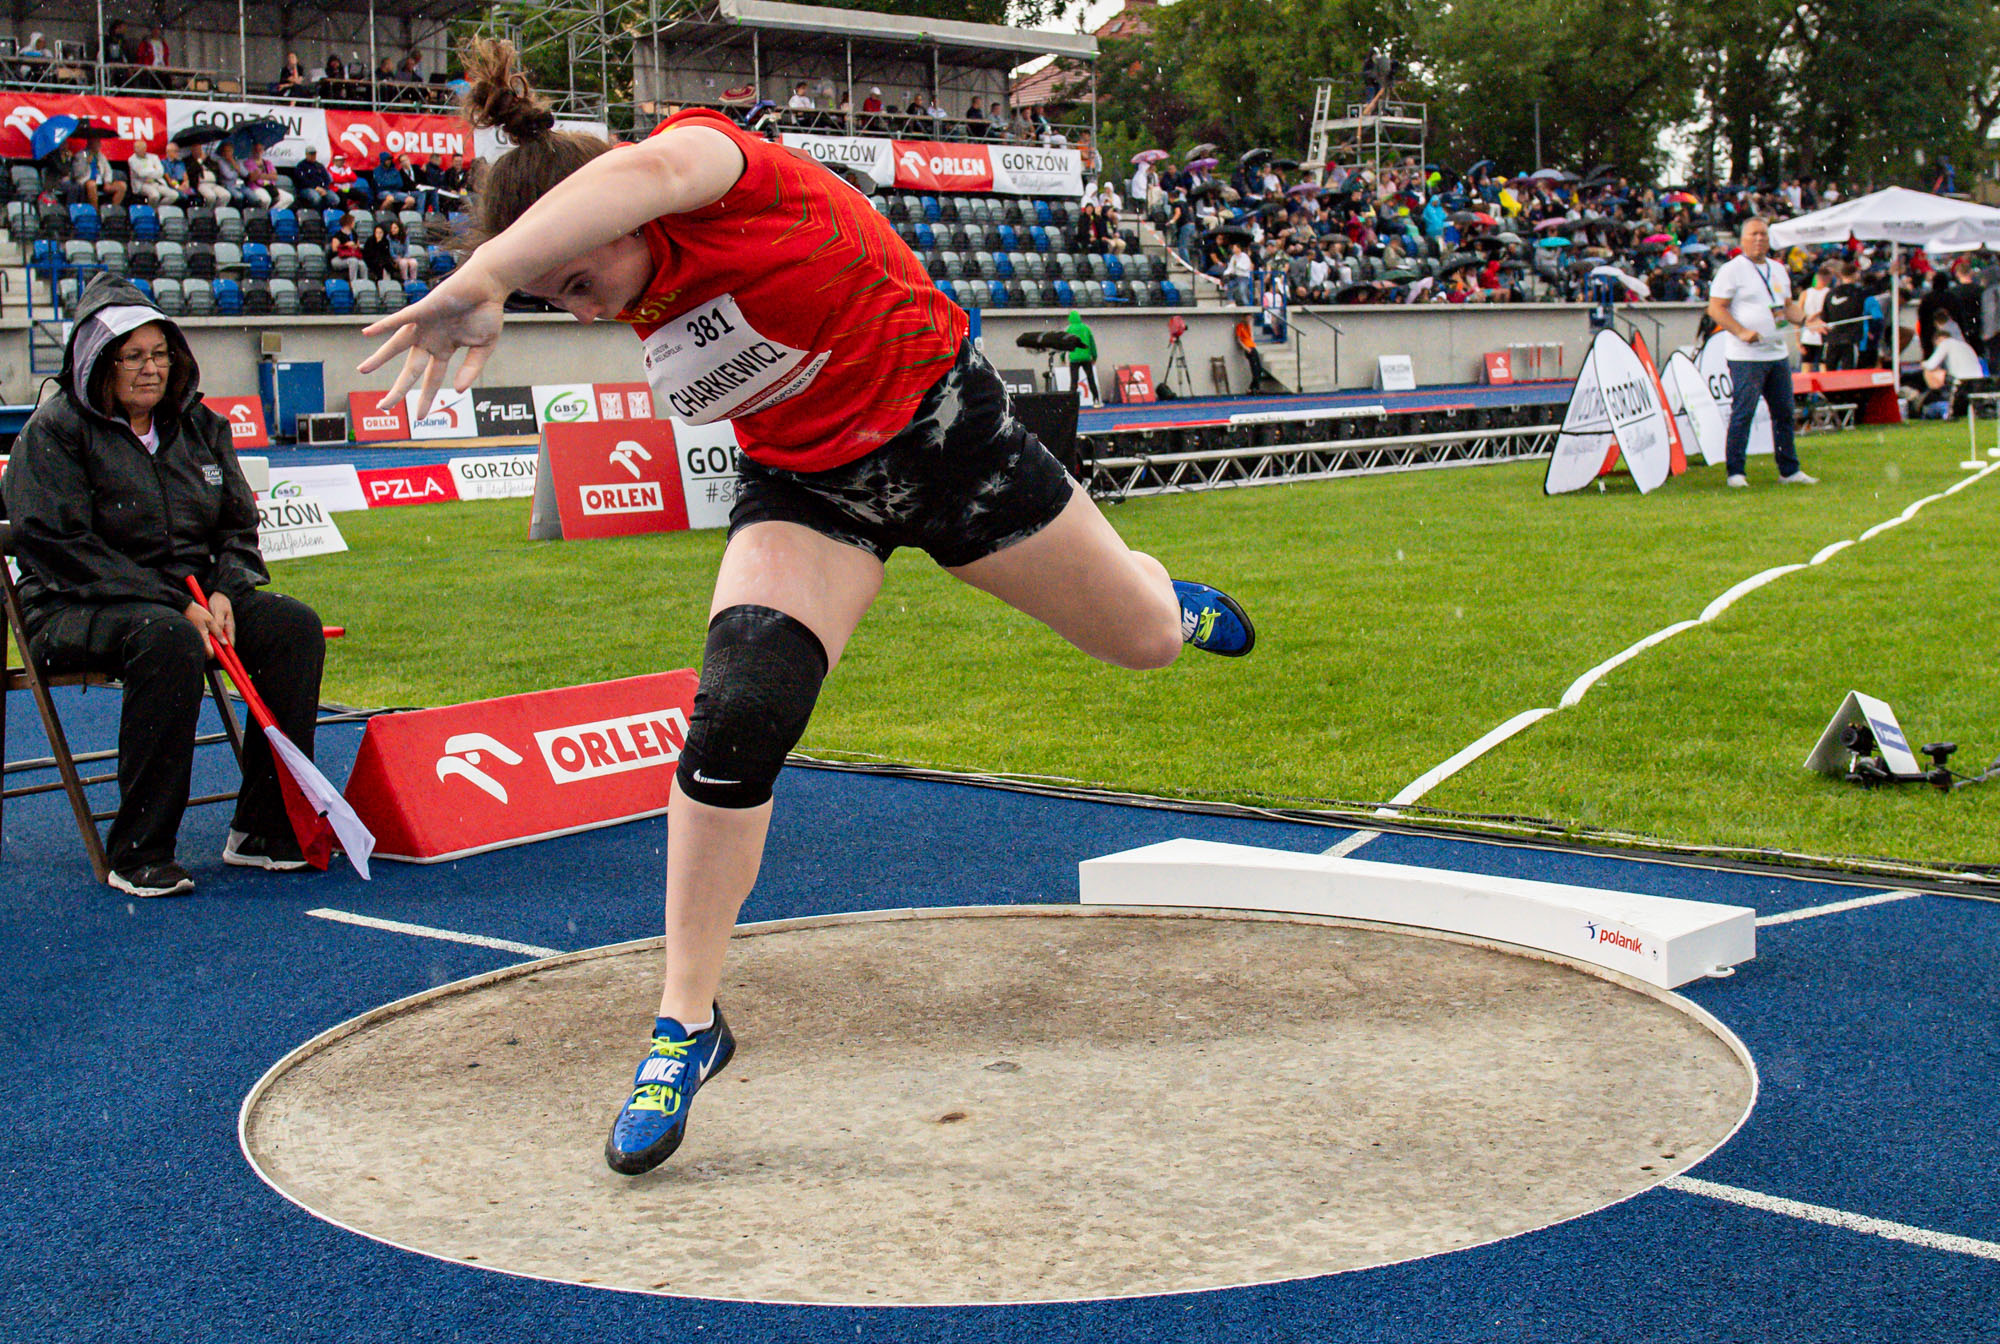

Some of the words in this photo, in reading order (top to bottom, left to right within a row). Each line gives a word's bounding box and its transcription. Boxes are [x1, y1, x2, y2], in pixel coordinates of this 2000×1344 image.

[385, 130, 463, 154] ORLEN
[929, 157, 985, 176] ORLEN
[1002, 151, 1068, 171] GORZÓW
[687, 308, 734, 347] 381
[669, 342, 788, 417] CHARKIEWICZ
[554, 404, 578, 413] GBS
[233, 425, 254, 435] LEN
[365, 418, 397, 429] ORLEN
[461, 457, 537, 479] GORZÓW
[370, 477, 444, 500] PZLA
[586, 487, 657, 510] ORLEN
[257, 499, 323, 529] RZÓW
[551, 717, 686, 773] ORLEN
[1599, 928, 1643, 955] polanik
[637, 1057, 686, 1084] NIKE
